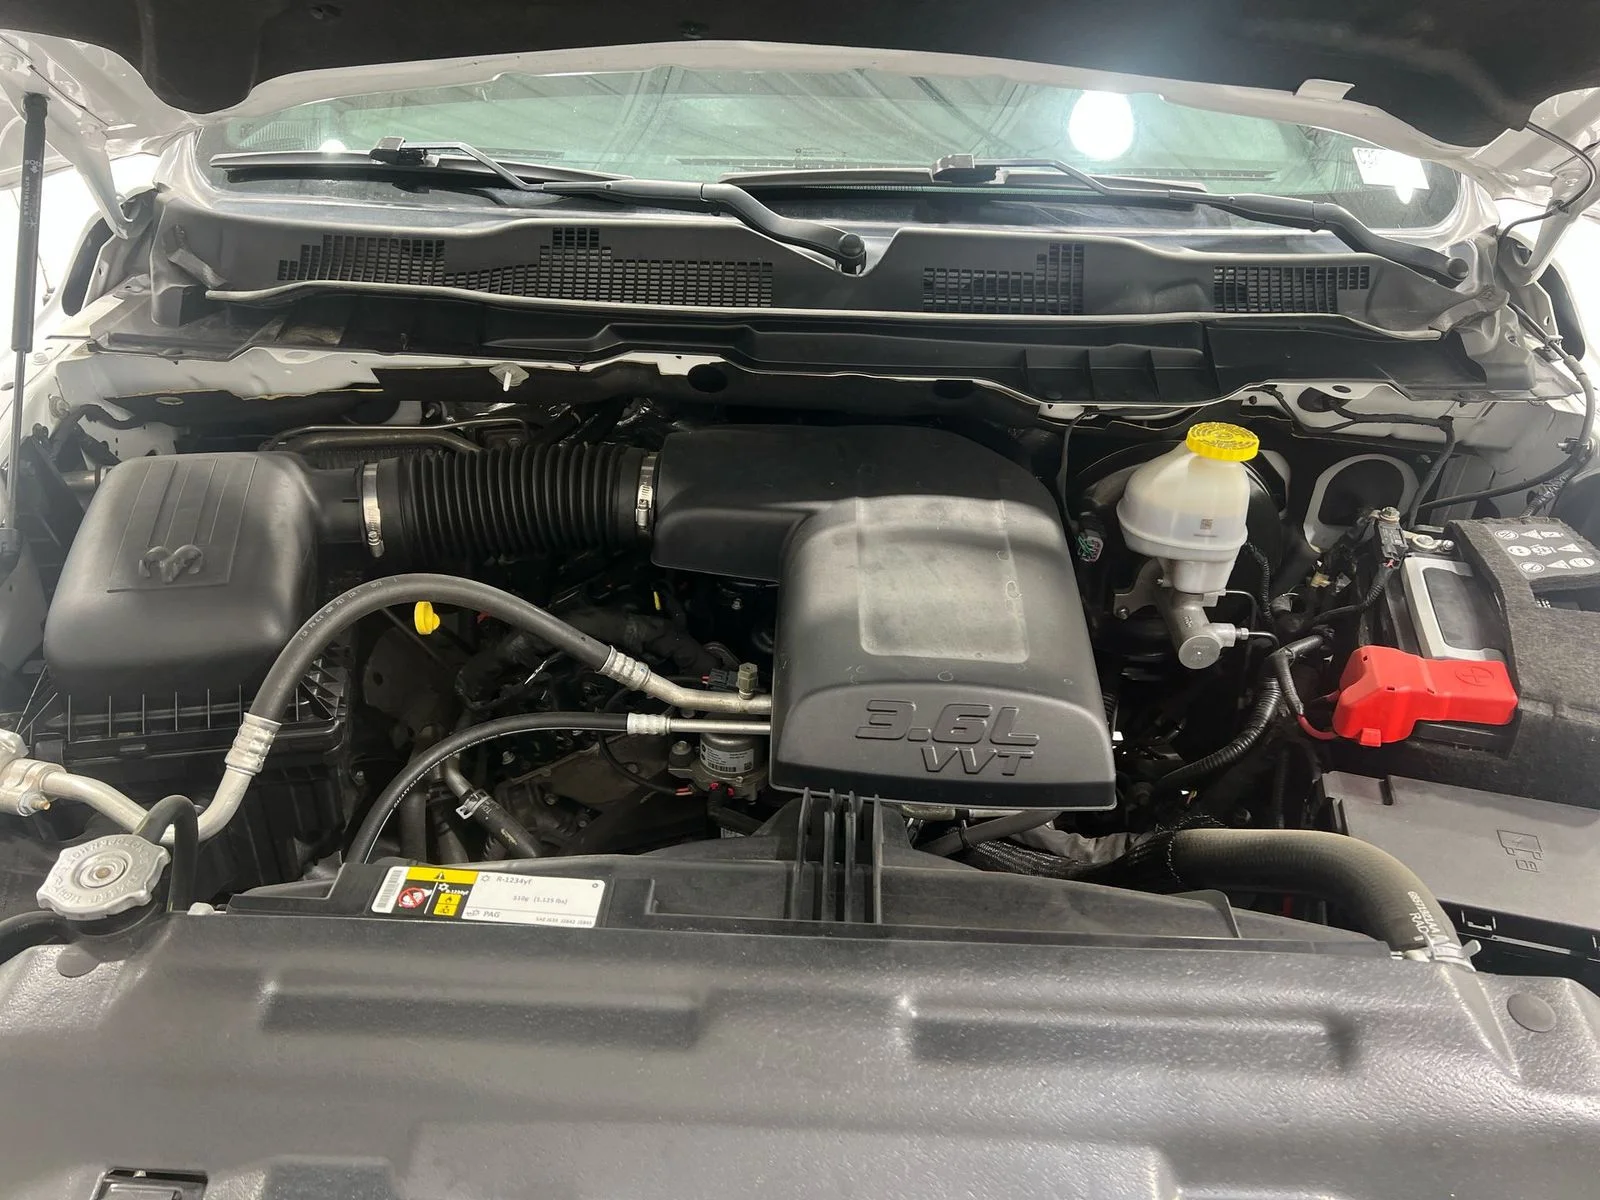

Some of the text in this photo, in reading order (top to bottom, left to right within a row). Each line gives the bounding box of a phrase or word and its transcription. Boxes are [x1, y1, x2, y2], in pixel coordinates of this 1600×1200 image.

[855, 699, 1040, 747] 3.6L
[920, 744, 1035, 777] VVT
[495, 875, 533, 886] R-1234yf
[482, 910, 501, 919] PAG
